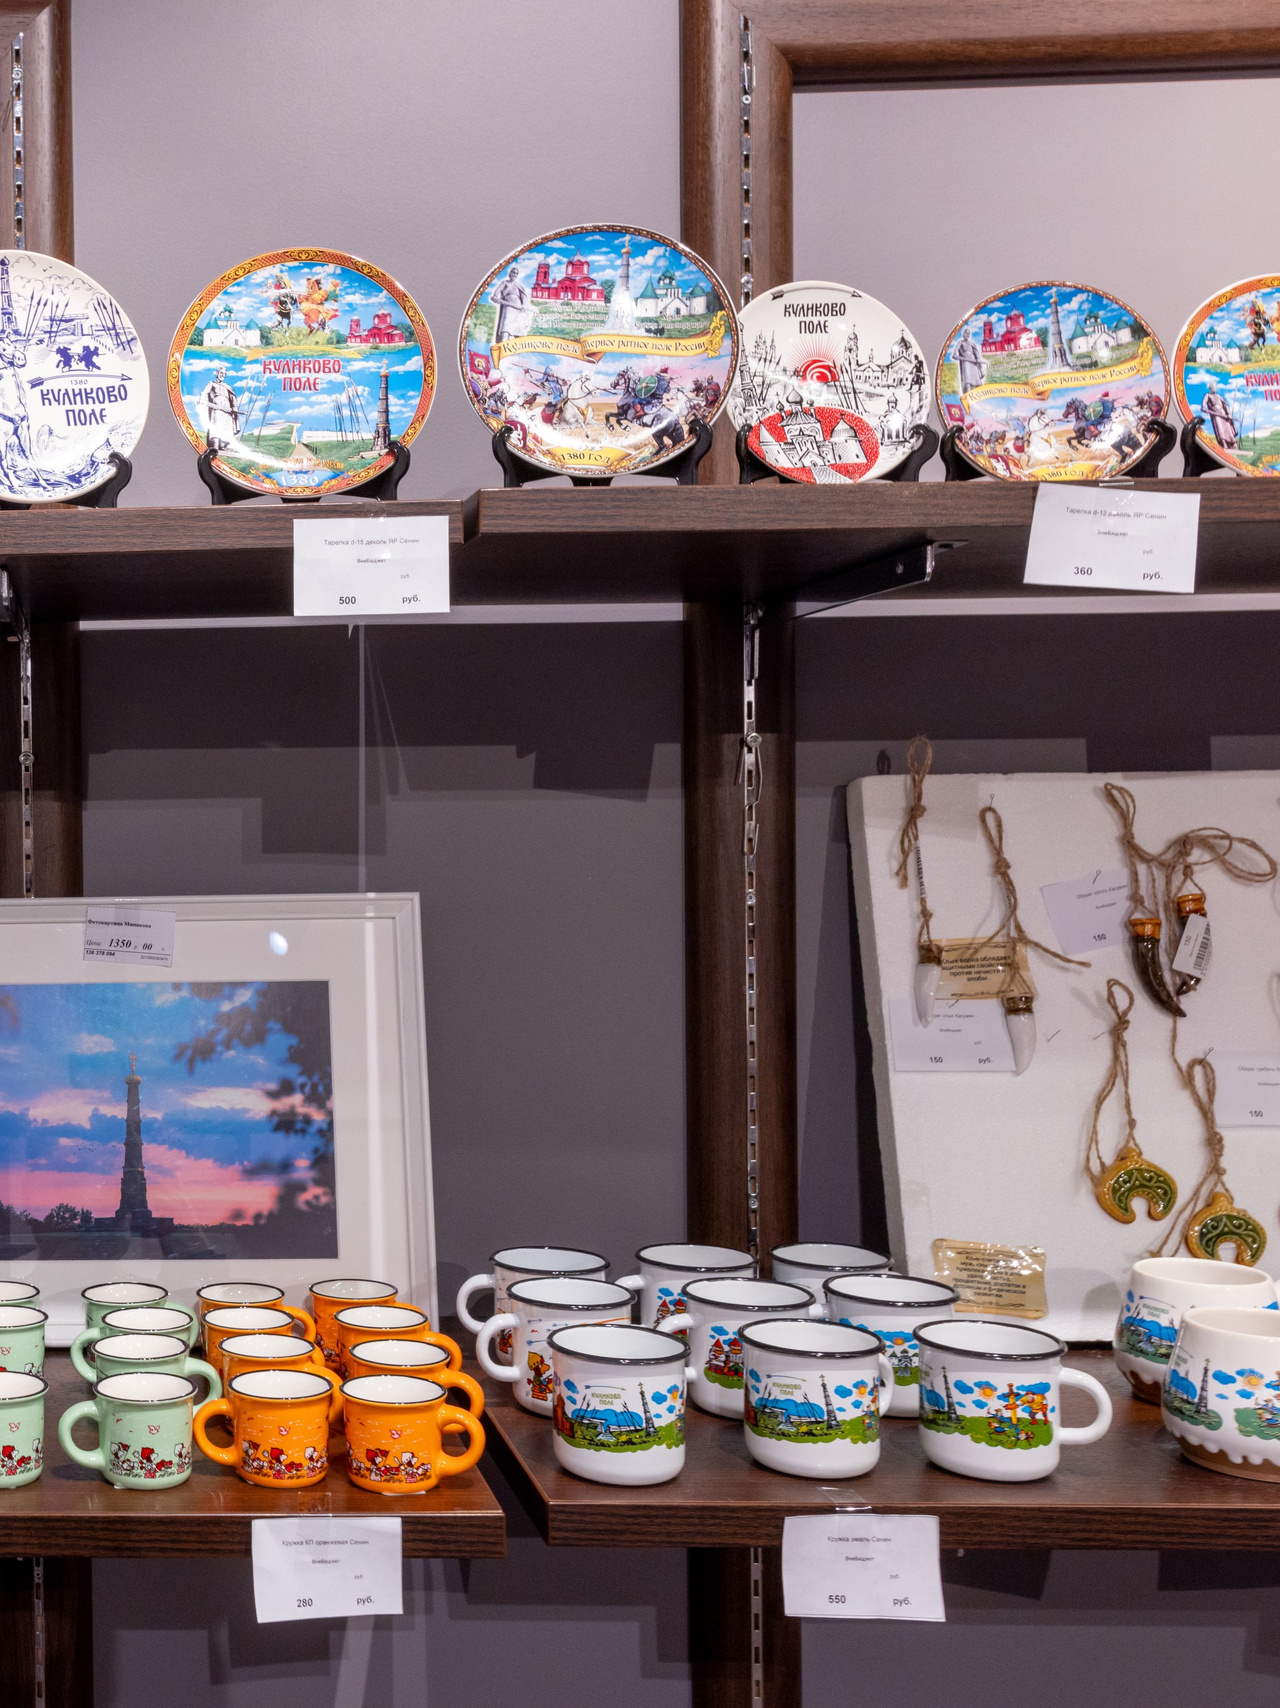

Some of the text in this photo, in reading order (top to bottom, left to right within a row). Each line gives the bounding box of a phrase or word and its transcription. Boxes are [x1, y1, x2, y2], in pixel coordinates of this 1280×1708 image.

[784, 302, 846, 318] КУЛИКОВО
[799, 320, 829, 334] ПОЛЕ
[502, 340, 581, 354] Куликово поле
[618, 339, 650, 350] ратное
[651, 341, 673, 352] поле
[674, 339, 707, 352] России
[262, 358, 342, 374] КУЛИКОВО
[282, 376, 320, 392] ПОЛЕ
[40, 384, 128, 406] КУЛИКОВО
[65, 408, 107, 426] ПОЛЕ
[561, 452, 611, 465] 1380 ГОД
[280, 475, 320, 486] 1380
[1041, 470, 1062, 481] 1380
[1066, 506, 1092, 515] Тарелка
[1074, 566, 1163, 580] 360 руб.
[338, 594, 421, 605] 500 руб.
[108, 938, 132, 948] 1350
[142, 942, 153, 950] 00
[1093, 934, 1107, 942] 150
[828, 1536, 850, 1544] Кружка
[297, 1596, 374, 1608] 280 руб.
[828, 1594, 912, 1607] 550 руб.
